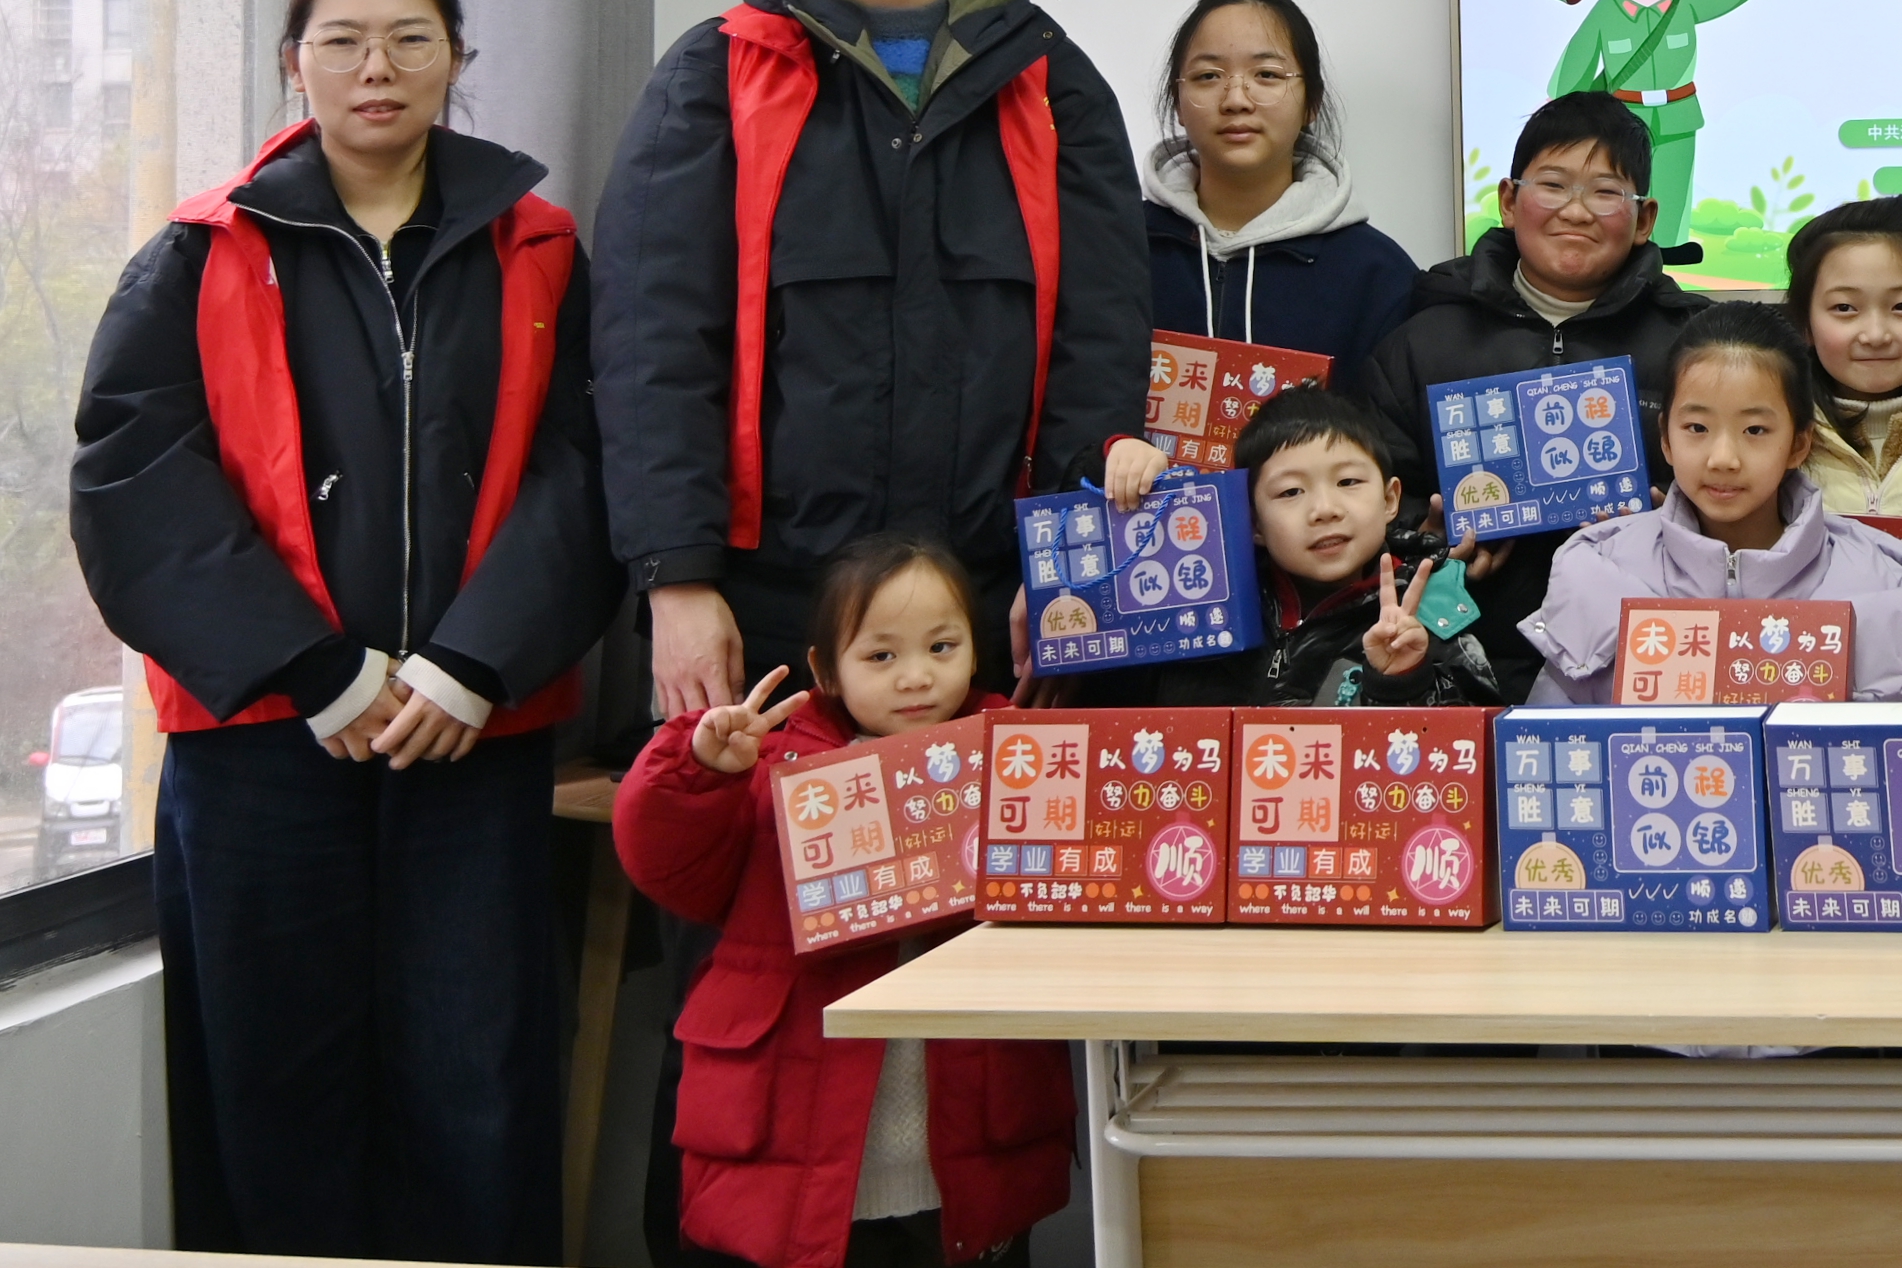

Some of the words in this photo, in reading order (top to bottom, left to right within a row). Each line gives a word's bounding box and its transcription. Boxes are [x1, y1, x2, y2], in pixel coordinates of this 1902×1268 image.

[1527, 388, 1548, 396] QIAN
[1553, 383, 1578, 391] CHENG
[1601, 376, 1619, 384] JING
[1542, 396, 1610, 426] 前程
[1447, 430, 1471, 438] SHENG
[1192, 494, 1211, 502] JING
[1462, 482, 1500, 504] 优秀
[1034, 508, 1053, 516] WAN
[1075, 503, 1089, 511] SHI
[1456, 506, 1538, 532] 未来可期
[1048, 608, 1087, 631] 优秀
[1636, 622, 1713, 657] 未来
[1729, 616, 1843, 654] 以梦为马
[1042, 636, 1125, 662] 未来可期
[1732, 661, 1828, 683] 努力奋斗
[1631, 670, 1707, 702] 可期
[1100, 729, 1221, 774] 以梦为马
[1517, 735, 1540, 744] WAN
[1569, 735, 1586, 744] SHI
[1621, 744, 1649, 753] QIAN
[1656, 744, 1688, 752] CHENG
[1696, 744, 1713, 752] SHI
[1719, 744, 1743, 752] JING
[1788, 740, 1812, 748] WAN
[1842, 740, 1860, 749] SHI
[1001, 739, 1082, 779] 未来
[1253, 739, 1336, 780] 未来
[1354, 730, 1477, 775] 以梦为马
[1514, 784, 1545, 793] SHENG
[1574, 784, 1586, 792] YI
[1639, 764, 1727, 797] 前程
[1787, 789, 1819, 797] SHENG
[1850, 788, 1862, 796] YI
[794, 772, 878, 822] 未来
[907, 784, 981, 821] 努力奋
[1104, 783, 1207, 808] 努力奋斗
[1358, 784, 1463, 809] 努力奋斗
[998, 796, 1078, 833] 可期
[1250, 796, 1332, 834] 可期
[801, 821, 884, 870] 可期
[990, 846, 1117, 873] 学业有成
[1243, 848, 1372, 876] 学业有成
[1526, 858, 1574, 882] 优秀
[802, 856, 933, 907] 学业有成
[1802, 861, 1852, 884] 优秀
[987, 901, 1017, 911] where
[1028, 901, 1053, 911] there
[1098, 903, 1114, 912] will
[1125, 903, 1151, 913] there
[1191, 905, 1212, 917] way
[1240, 904, 1270, 913] where
[1282, 904, 1307, 914] there
[1354, 906, 1369, 915] will
[1381, 906, 1407, 916] there
[1448, 909, 1470, 921] way
[1515, 897, 1620, 917] 未来可期
[1792, 898, 1901, 918] 未来可期
